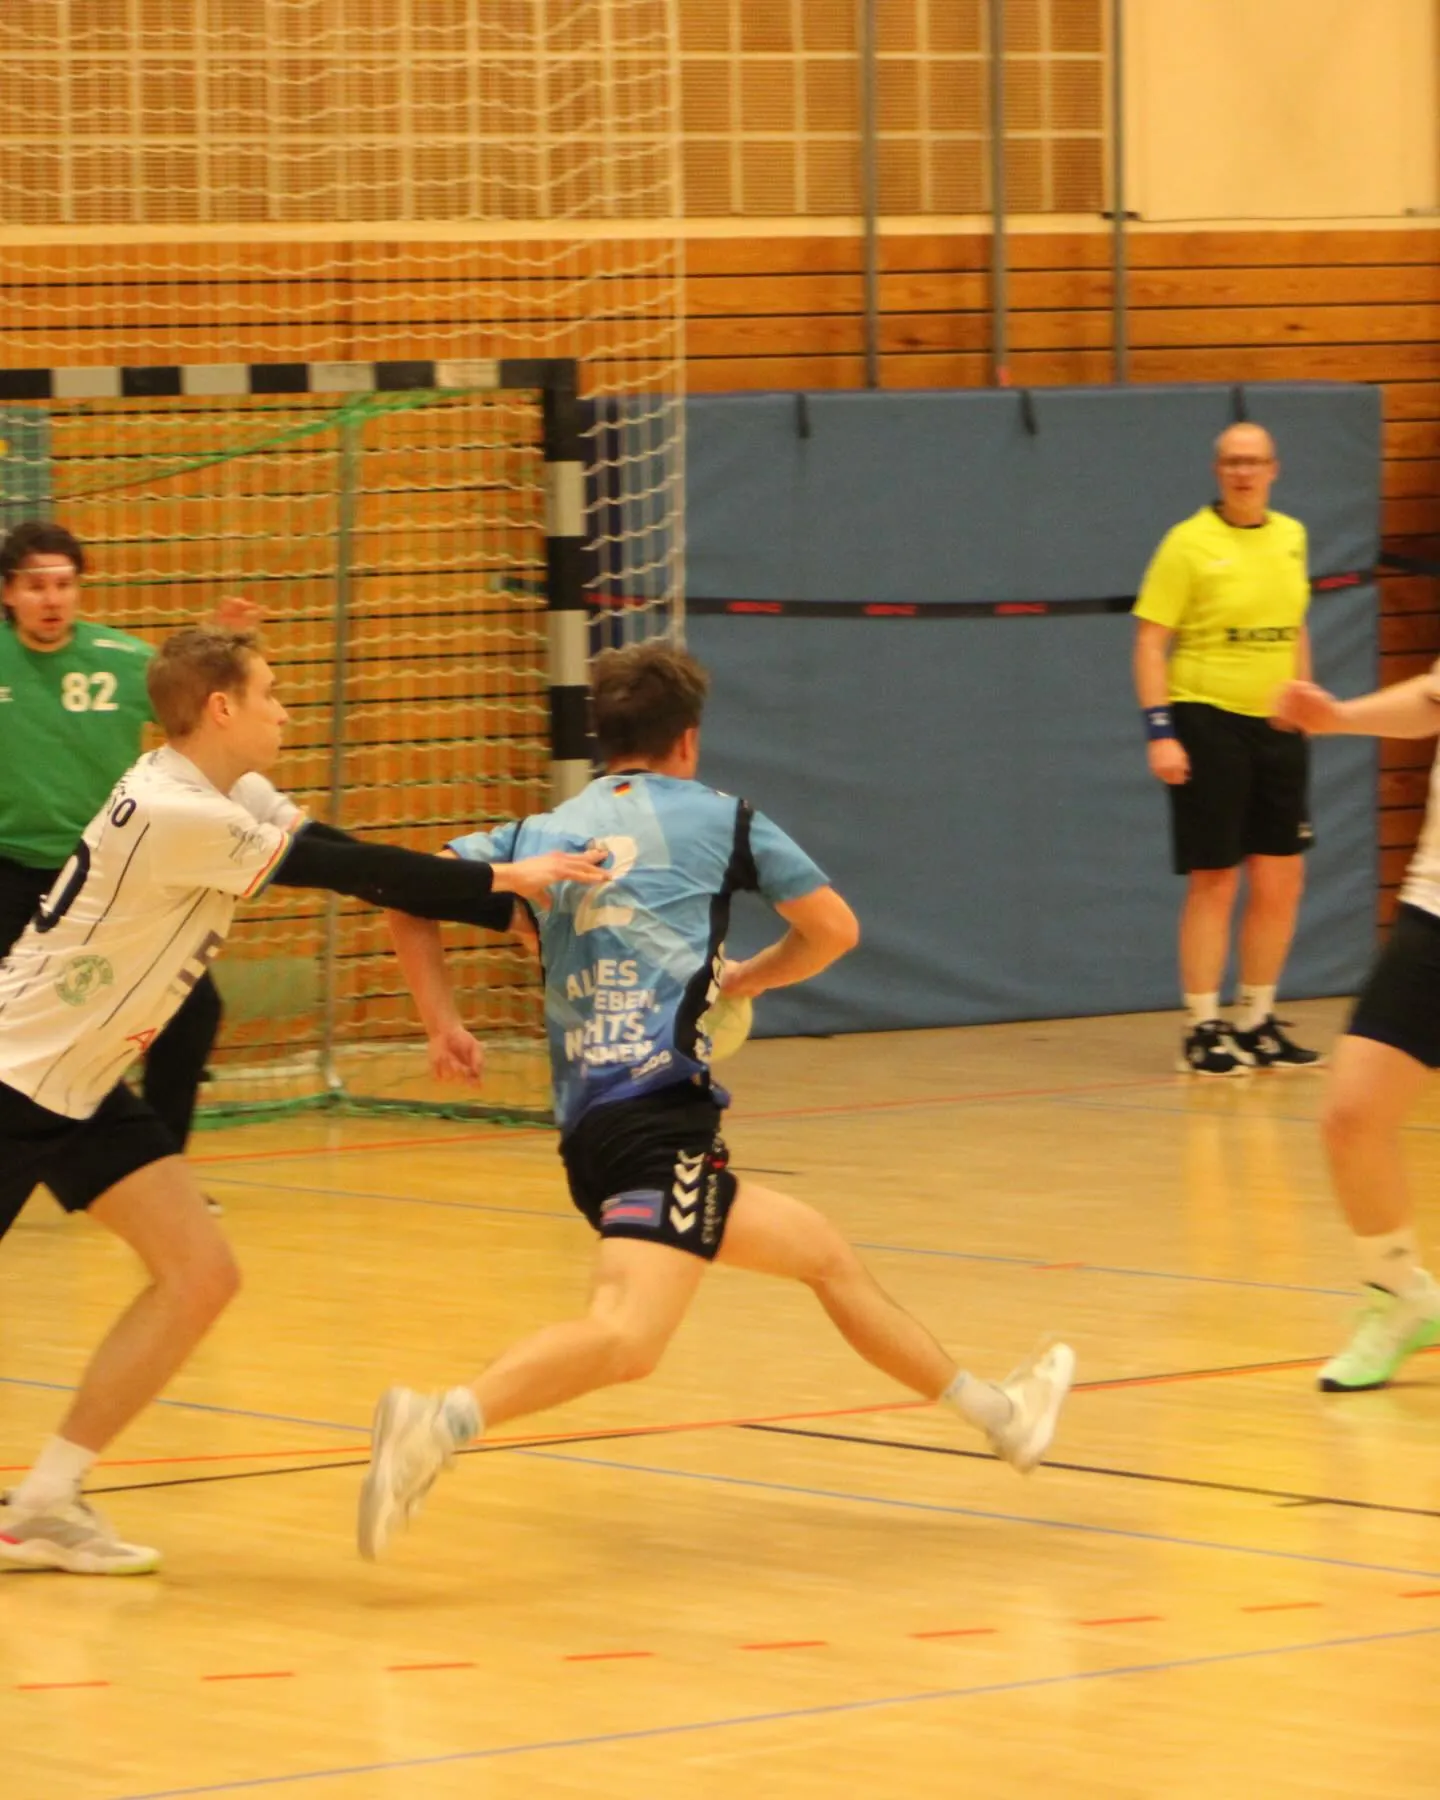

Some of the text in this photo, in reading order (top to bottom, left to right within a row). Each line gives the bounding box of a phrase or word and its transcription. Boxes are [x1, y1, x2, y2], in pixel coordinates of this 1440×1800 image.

[62, 671, 119, 712] 82
[566, 959, 638, 1001] ALES
[594, 988, 660, 1013] EBEN.
